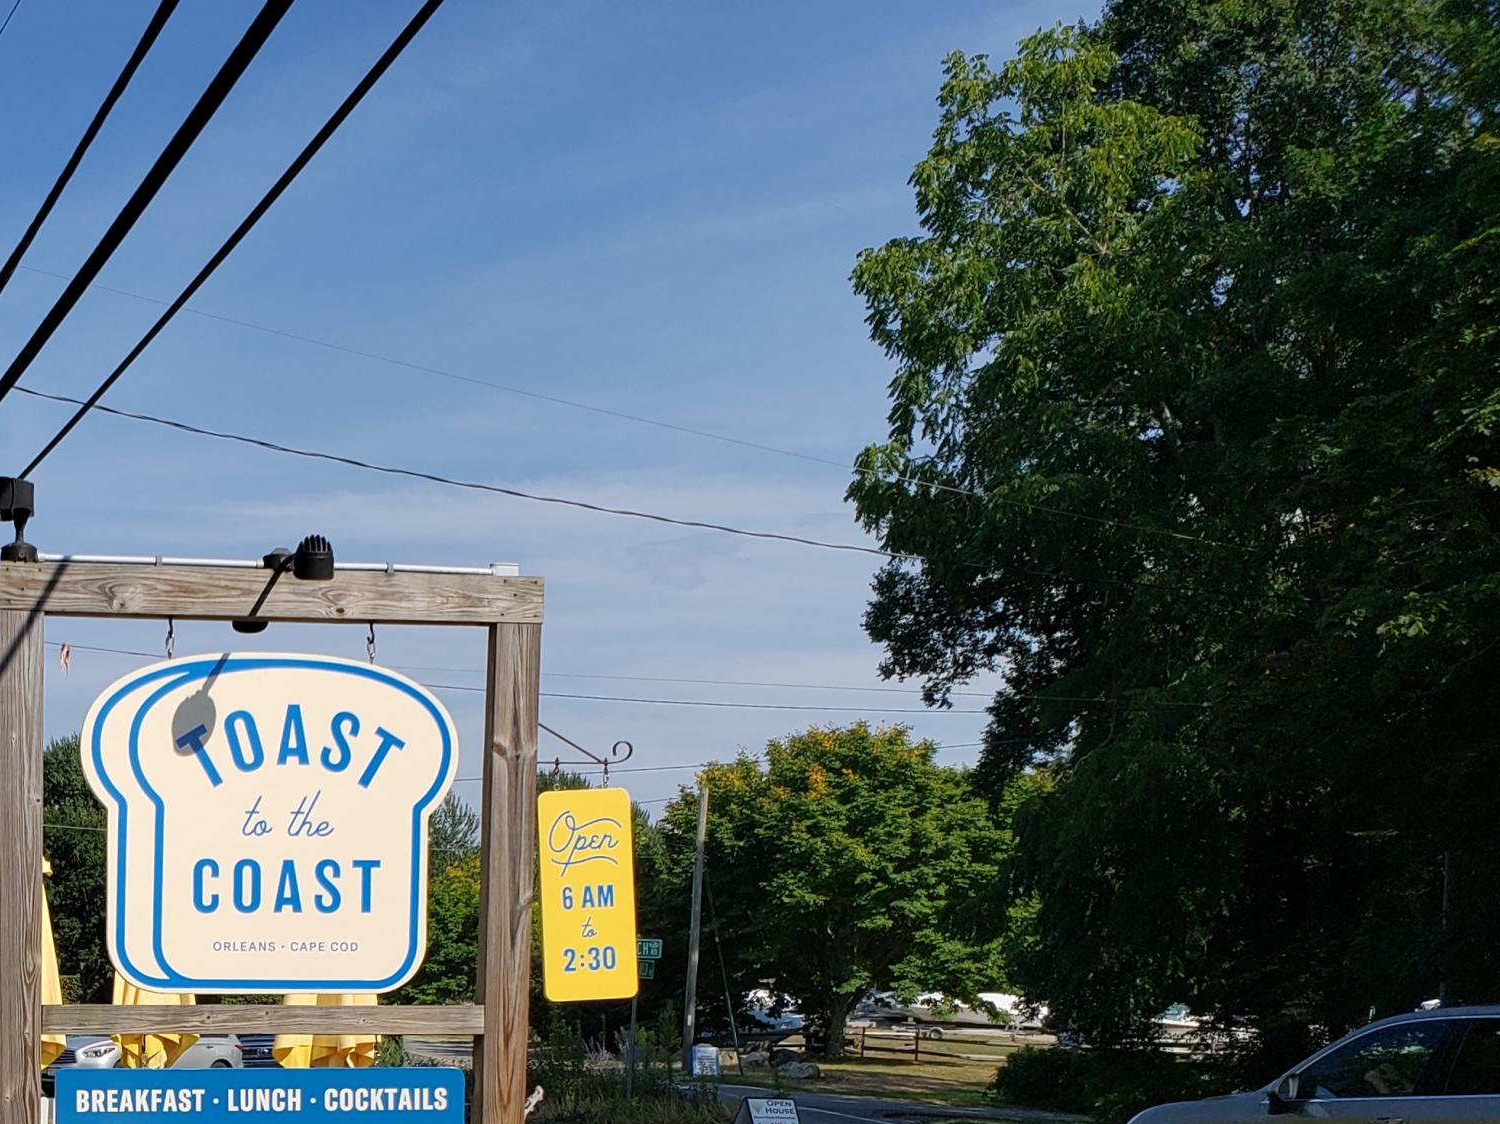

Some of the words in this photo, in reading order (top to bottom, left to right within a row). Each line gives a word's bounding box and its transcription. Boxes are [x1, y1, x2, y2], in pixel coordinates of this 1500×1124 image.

[176, 704, 406, 789] TOAST
[241, 795, 273, 837] to
[286, 789, 335, 837] the
[548, 810, 622, 877] Open
[192, 857, 382, 914] COAST
[562, 886, 574, 910] 6
[581, 884, 615, 909] AM
[580, 916, 598, 938] to
[212, 941, 277, 952] ORLEANS
[290, 941, 326, 952] CAPE
[330, 941, 359, 952] COD
[562, 945, 617, 972] 2:30
[75, 1088, 206, 1113] BREAKFAST
[227, 1088, 302, 1112] LUNCH
[324, 1087, 448, 1112] COCKTAILS
